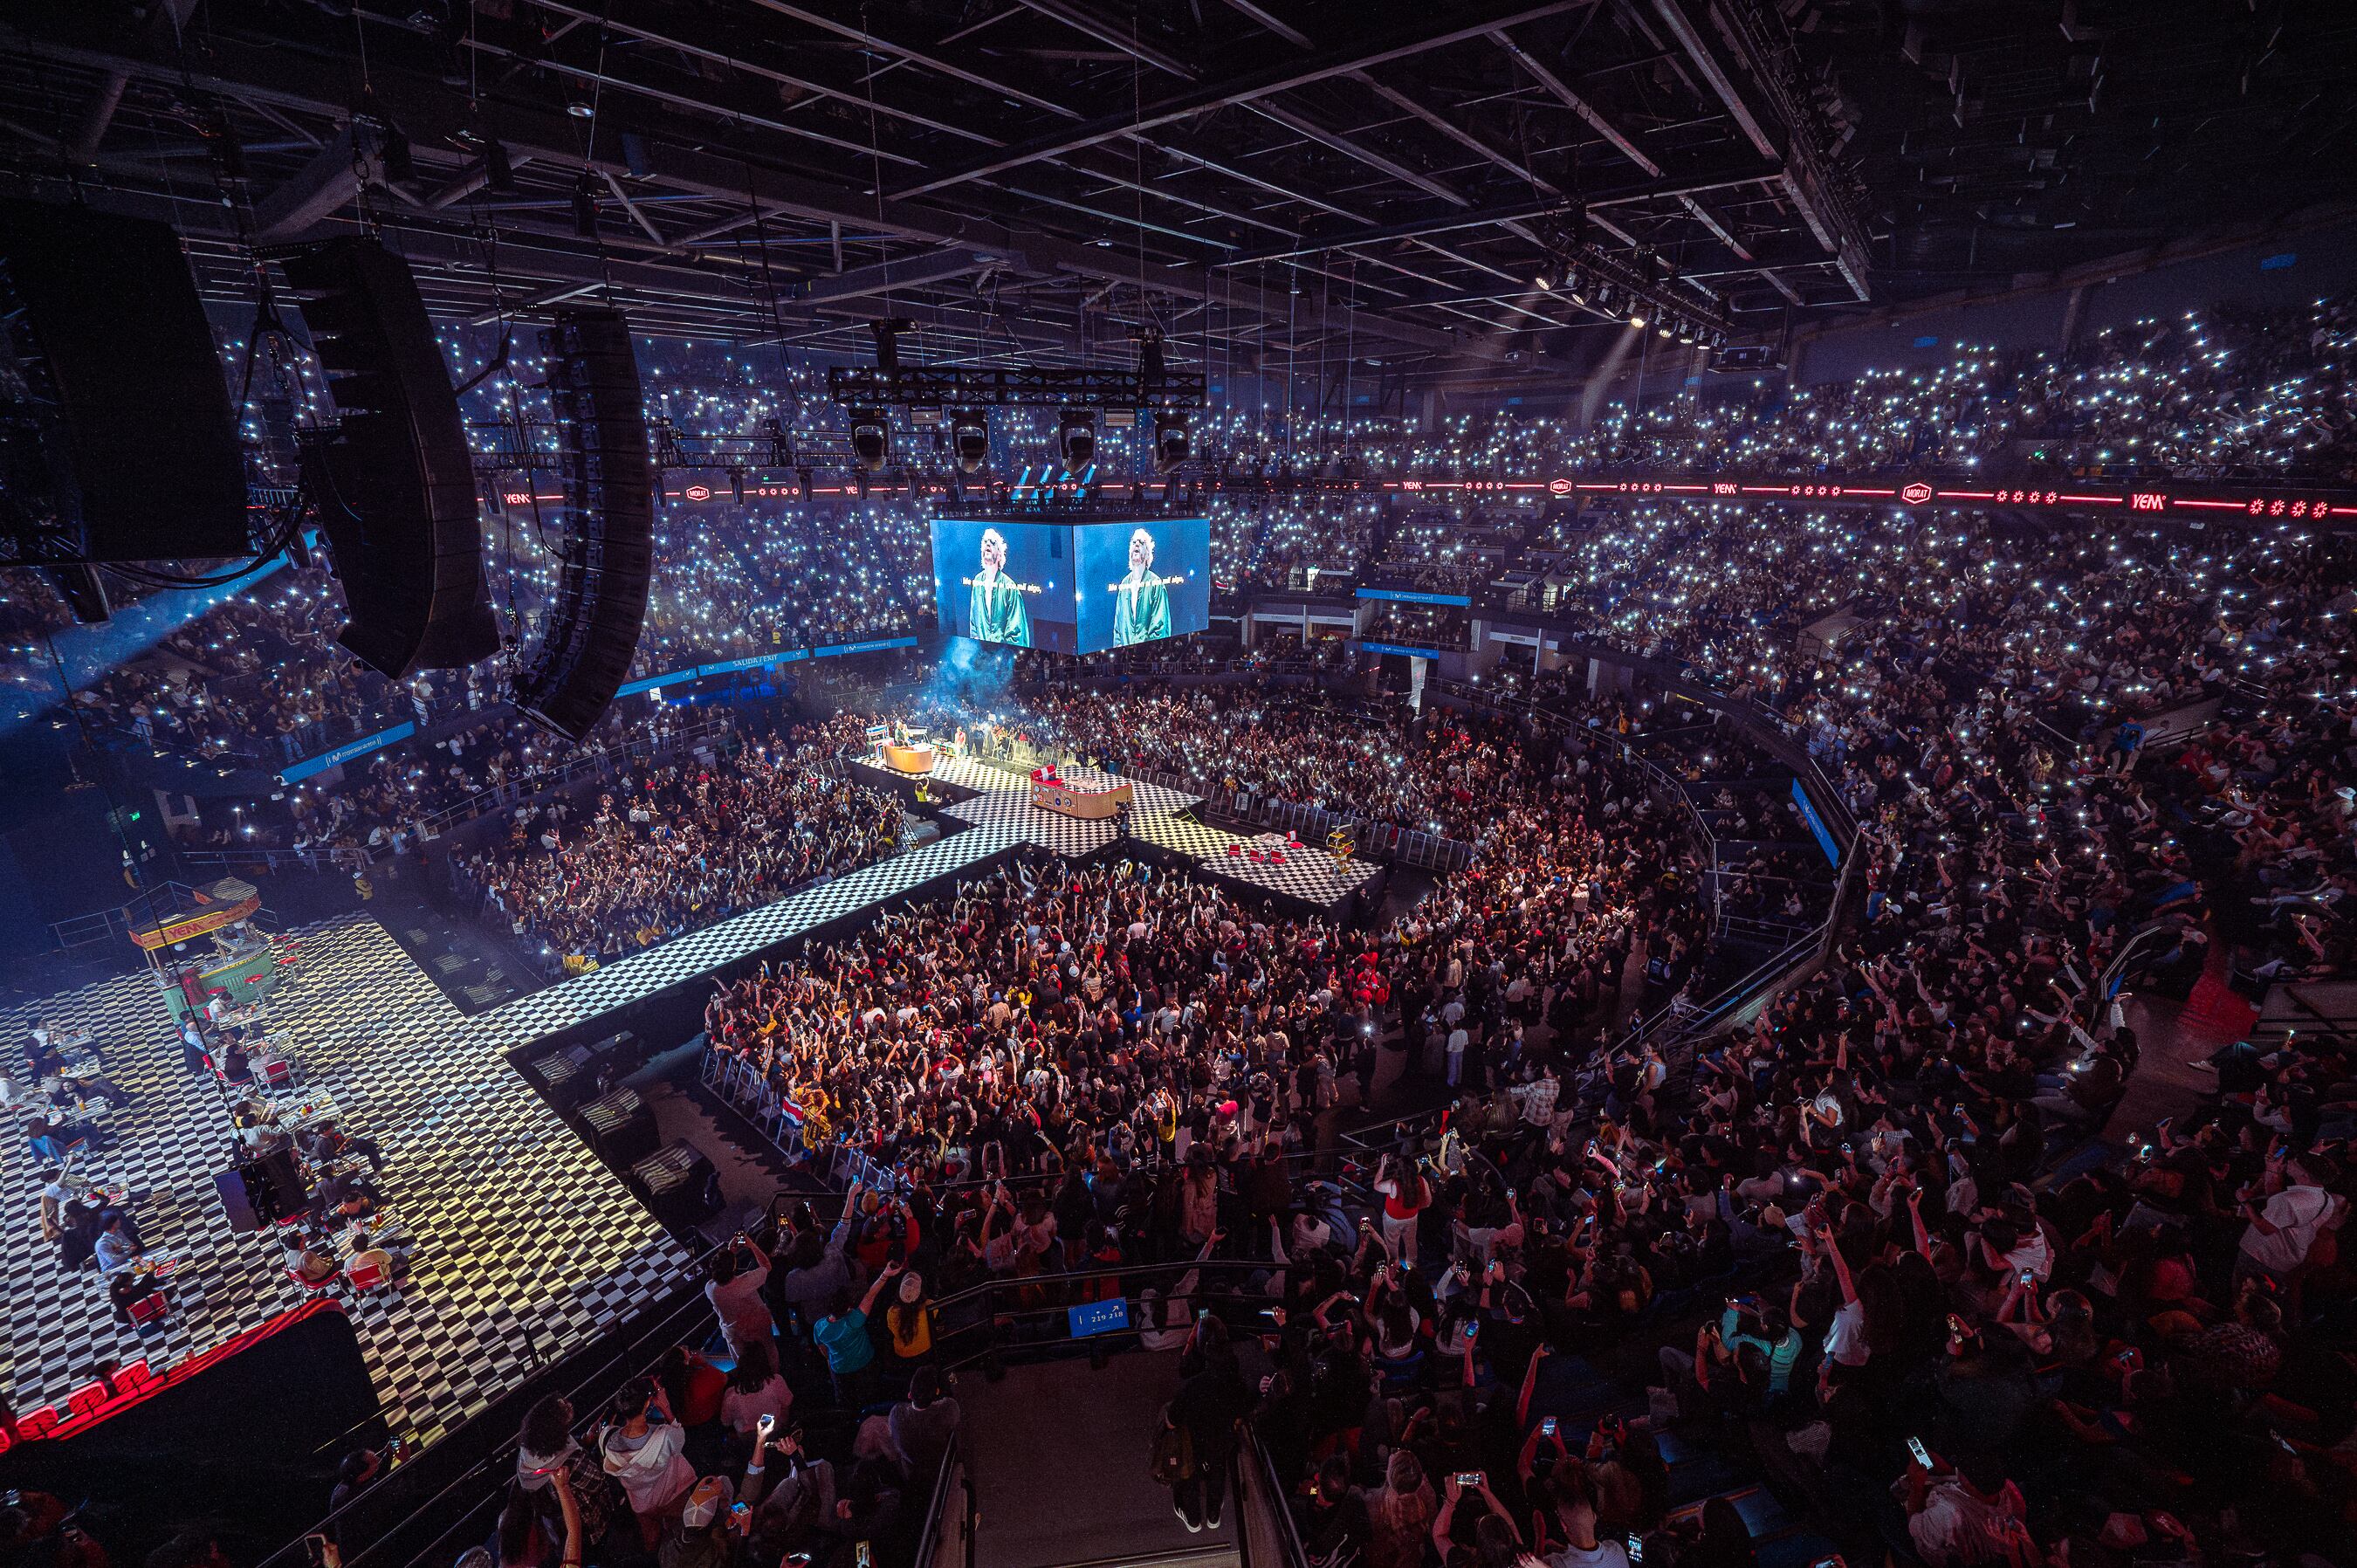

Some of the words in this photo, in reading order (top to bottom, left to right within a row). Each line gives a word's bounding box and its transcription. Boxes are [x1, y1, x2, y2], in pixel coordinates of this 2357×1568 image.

[1906, 488, 1928, 499] MORAT
[732, 657, 758, 667] SALIDA
[764, 653, 778, 662] EXIT
[1091, 1314, 1106, 1323] 219
[1109, 1310, 1124, 1319] 218
